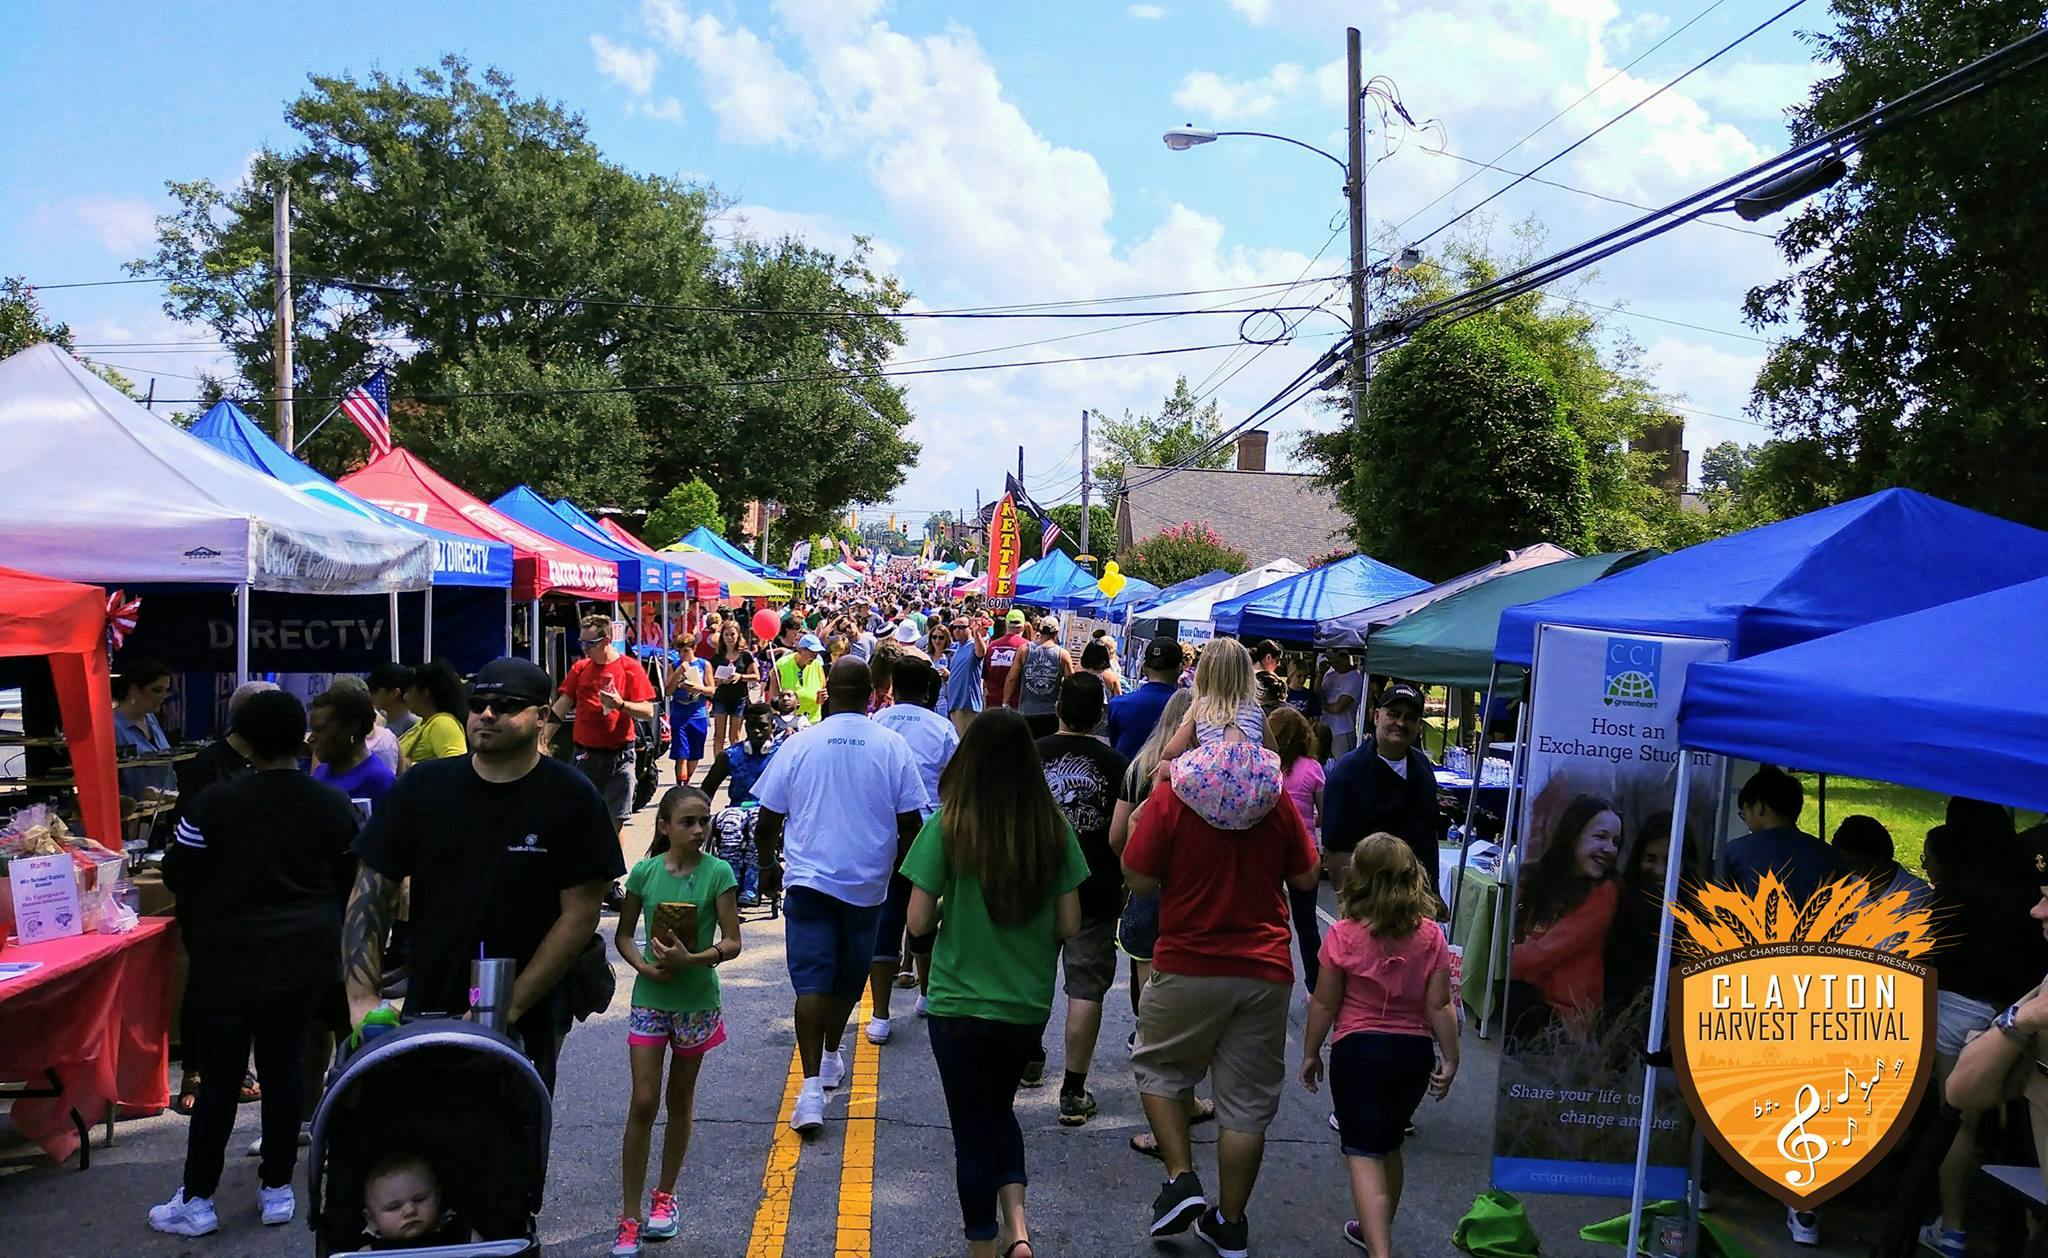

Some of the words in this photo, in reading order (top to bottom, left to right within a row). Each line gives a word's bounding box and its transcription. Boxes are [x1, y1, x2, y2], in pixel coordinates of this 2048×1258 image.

[447, 539, 491, 576] DIRECTV
[996, 502, 1016, 596] KETTLE
[548, 559, 583, 587] ENTER
[578, 564, 597, 591] TO
[988, 597, 1013, 610] CORN
[207, 618, 385, 651] DRECTV
[1610, 644, 1655, 667] CCI
[1614, 699, 1658, 709] greenheart
[1591, 717, 1635, 738] Host
[1641, 725, 1665, 740] an
[1537, 735, 1633, 764] Exchange
[1639, 744, 1712, 767] Studnt
[1509, 1084, 1555, 1099] Share
[1558, 1089, 1594, 1104] your
[1599, 1089, 1622, 1105] life
[1627, 1092, 1642, 1105] to
[1559, 1109, 1615, 1130] change
[1618, 1113, 1680, 1131] anoher
